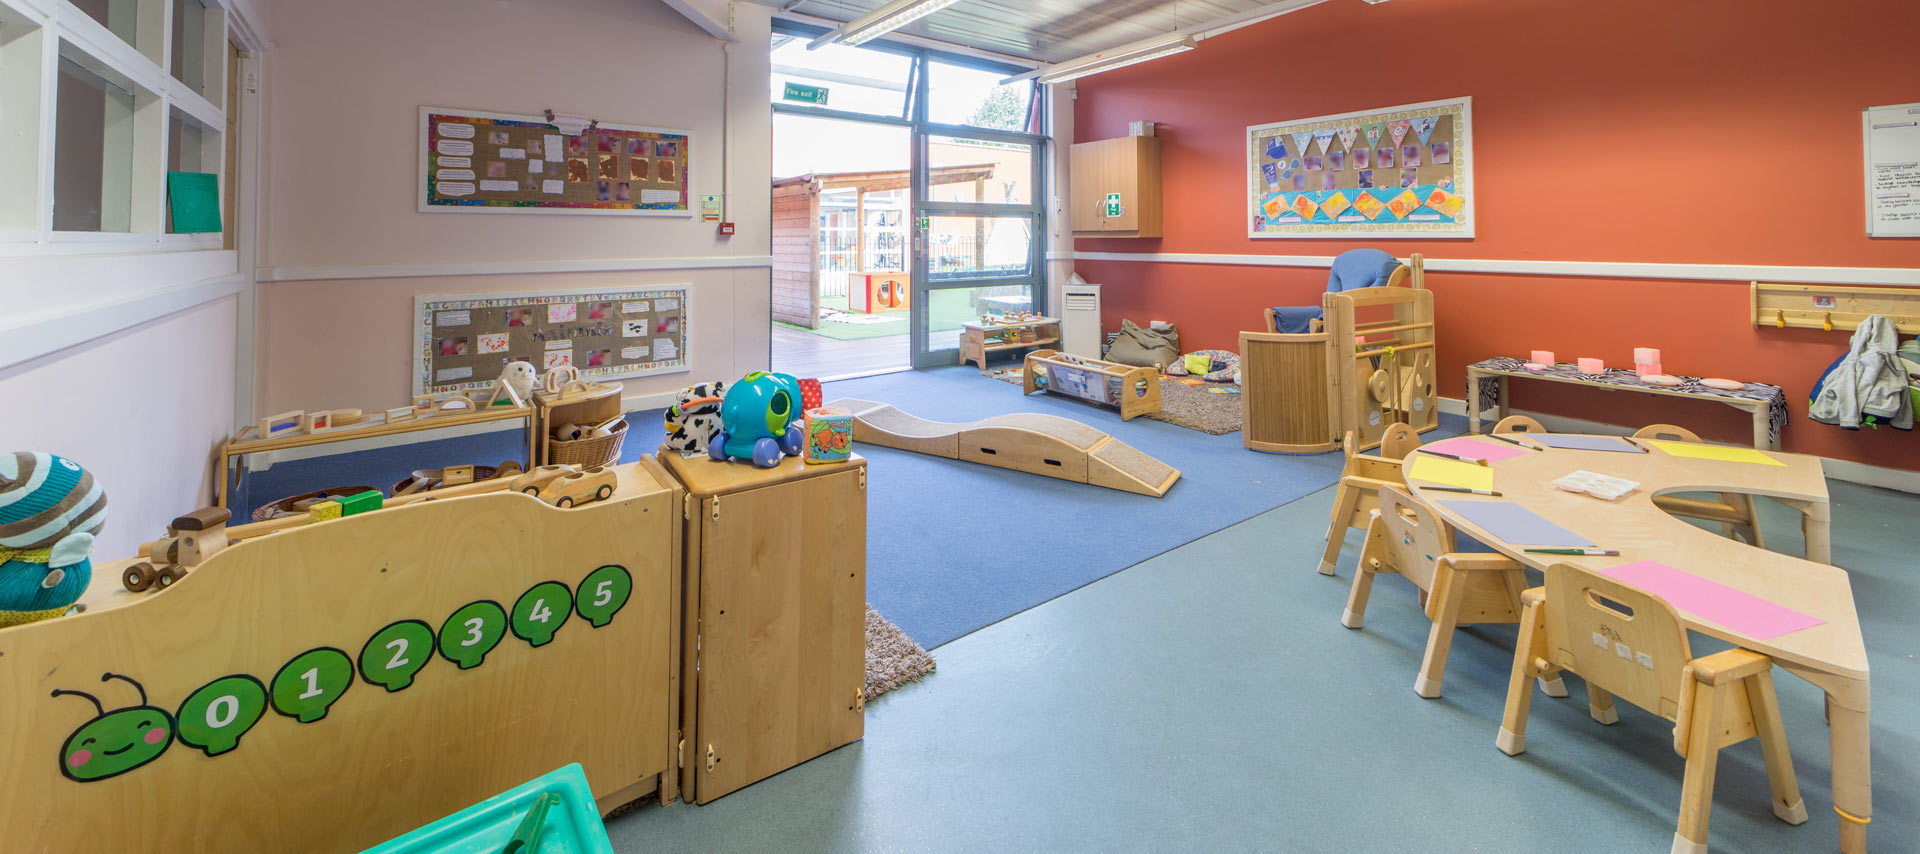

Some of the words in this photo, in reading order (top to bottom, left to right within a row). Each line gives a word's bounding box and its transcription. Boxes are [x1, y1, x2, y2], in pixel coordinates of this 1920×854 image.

[787, 88, 799, 96] Fire
[206, 696, 239, 728] 0
[299, 668, 323, 699] 1
[386, 639, 408, 669] 2
[461, 618, 483, 646] 3
[529, 599, 552, 623] 4
[594, 581, 612, 606] 5
